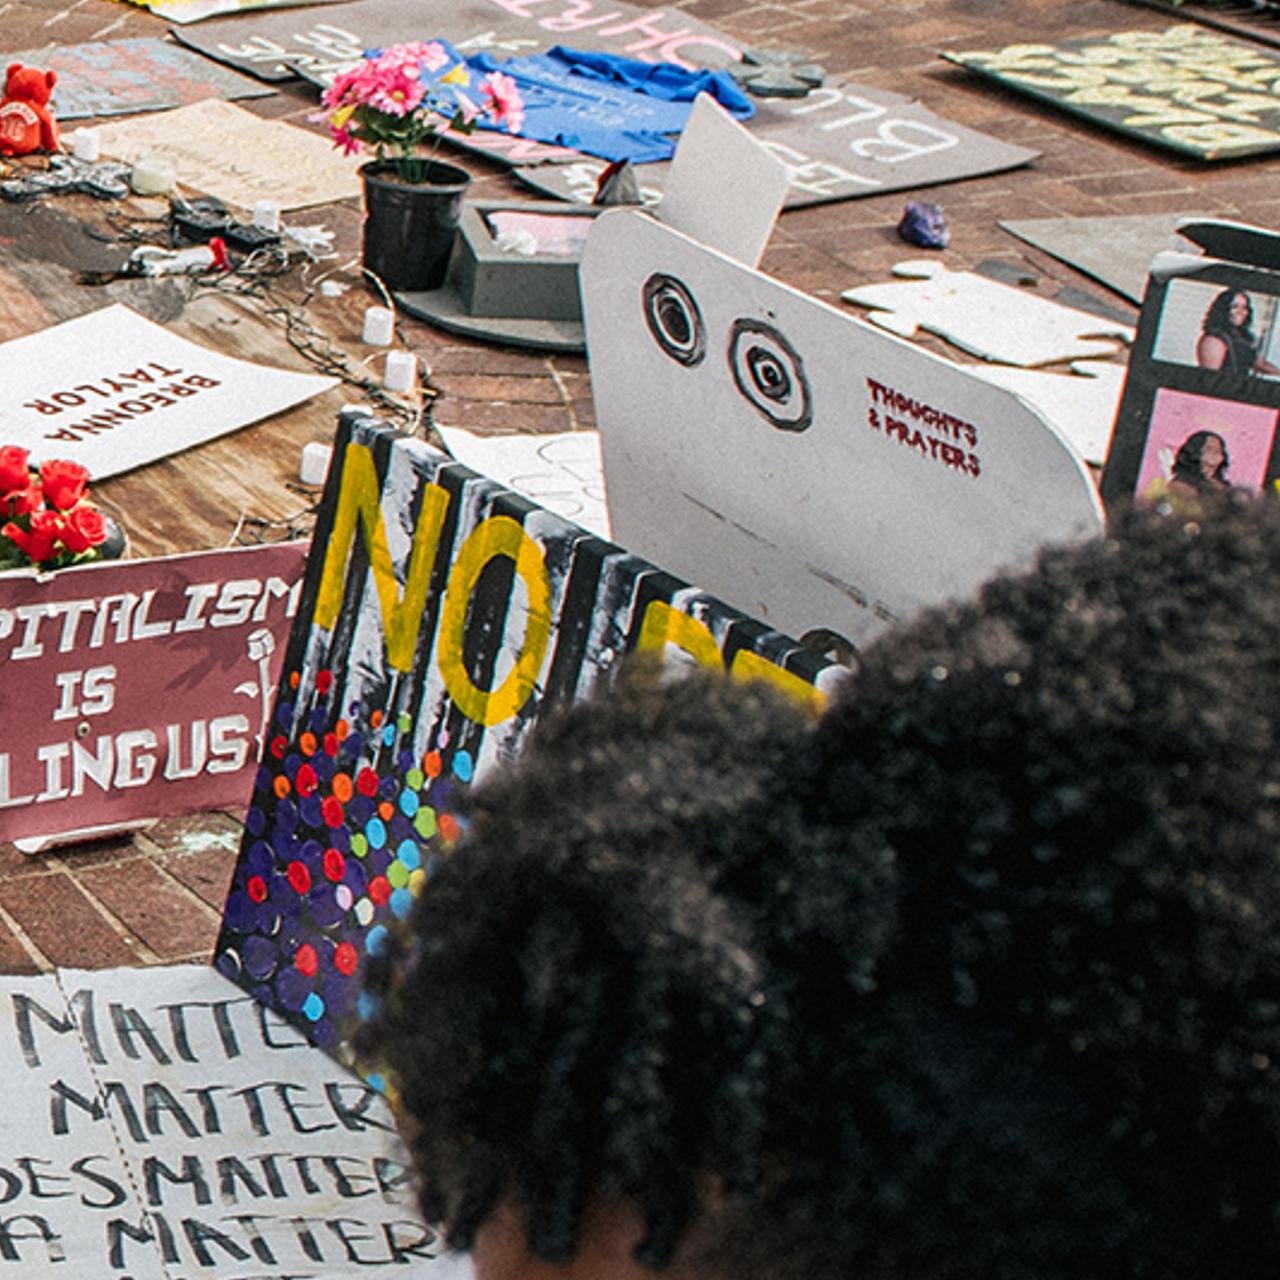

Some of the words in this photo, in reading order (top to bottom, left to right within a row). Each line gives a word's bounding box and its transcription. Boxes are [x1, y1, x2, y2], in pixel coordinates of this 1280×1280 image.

[22, 362, 184, 415] TAYLOR
[43, 374, 222, 442] BREONNA
[865, 376, 978, 448] THOUGHTS
[884, 414, 981, 478] PRAYERS
[313, 442, 552, 727] NO
[52, 664, 118, 721] IS
[11, 987, 320, 1069] MATTE
[49, 1079, 402, 1144] MATTER
[141, 1152, 416, 1207] MATTER
[107, 1212, 439, 1269] MATTER
